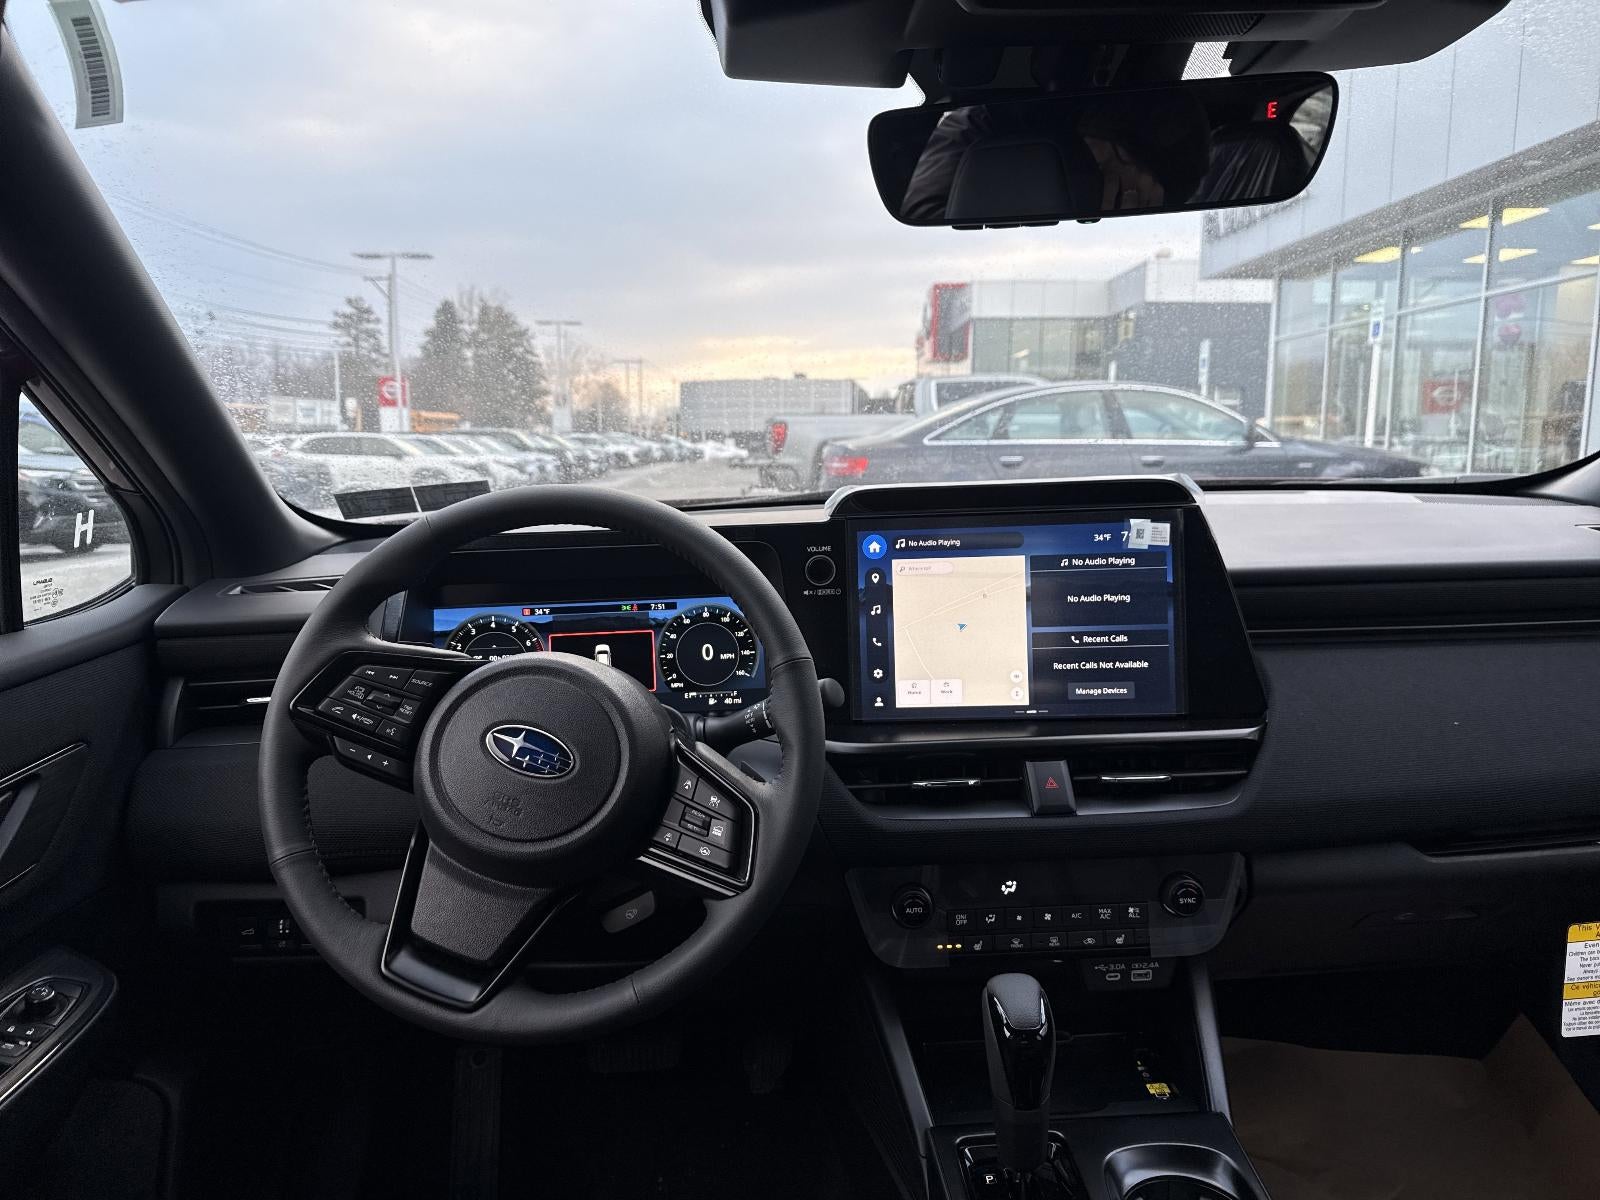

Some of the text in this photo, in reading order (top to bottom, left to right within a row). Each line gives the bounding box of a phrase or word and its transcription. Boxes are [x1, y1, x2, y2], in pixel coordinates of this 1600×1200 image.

[1267, 101, 1278, 119] E
[73, 509, 95, 549] H
[908, 538, 961, 548] No Audio Playing
[806, 545, 832, 553] VOLUME
[1072, 556, 1136, 567] No Audio Playing
[1067, 593, 1131, 604] No Audio Playing
[525, 639, 531, 647] 6
[1083, 634, 1129, 643] Recent Calls
[701, 643, 714, 661] 0
[1053, 660, 1149, 670] Recent Calls Not Available
[1075, 687, 1128, 697] Manage Devices
[1179, 897, 1197, 905] SYNC
[985, 1175, 994, 1184] P
